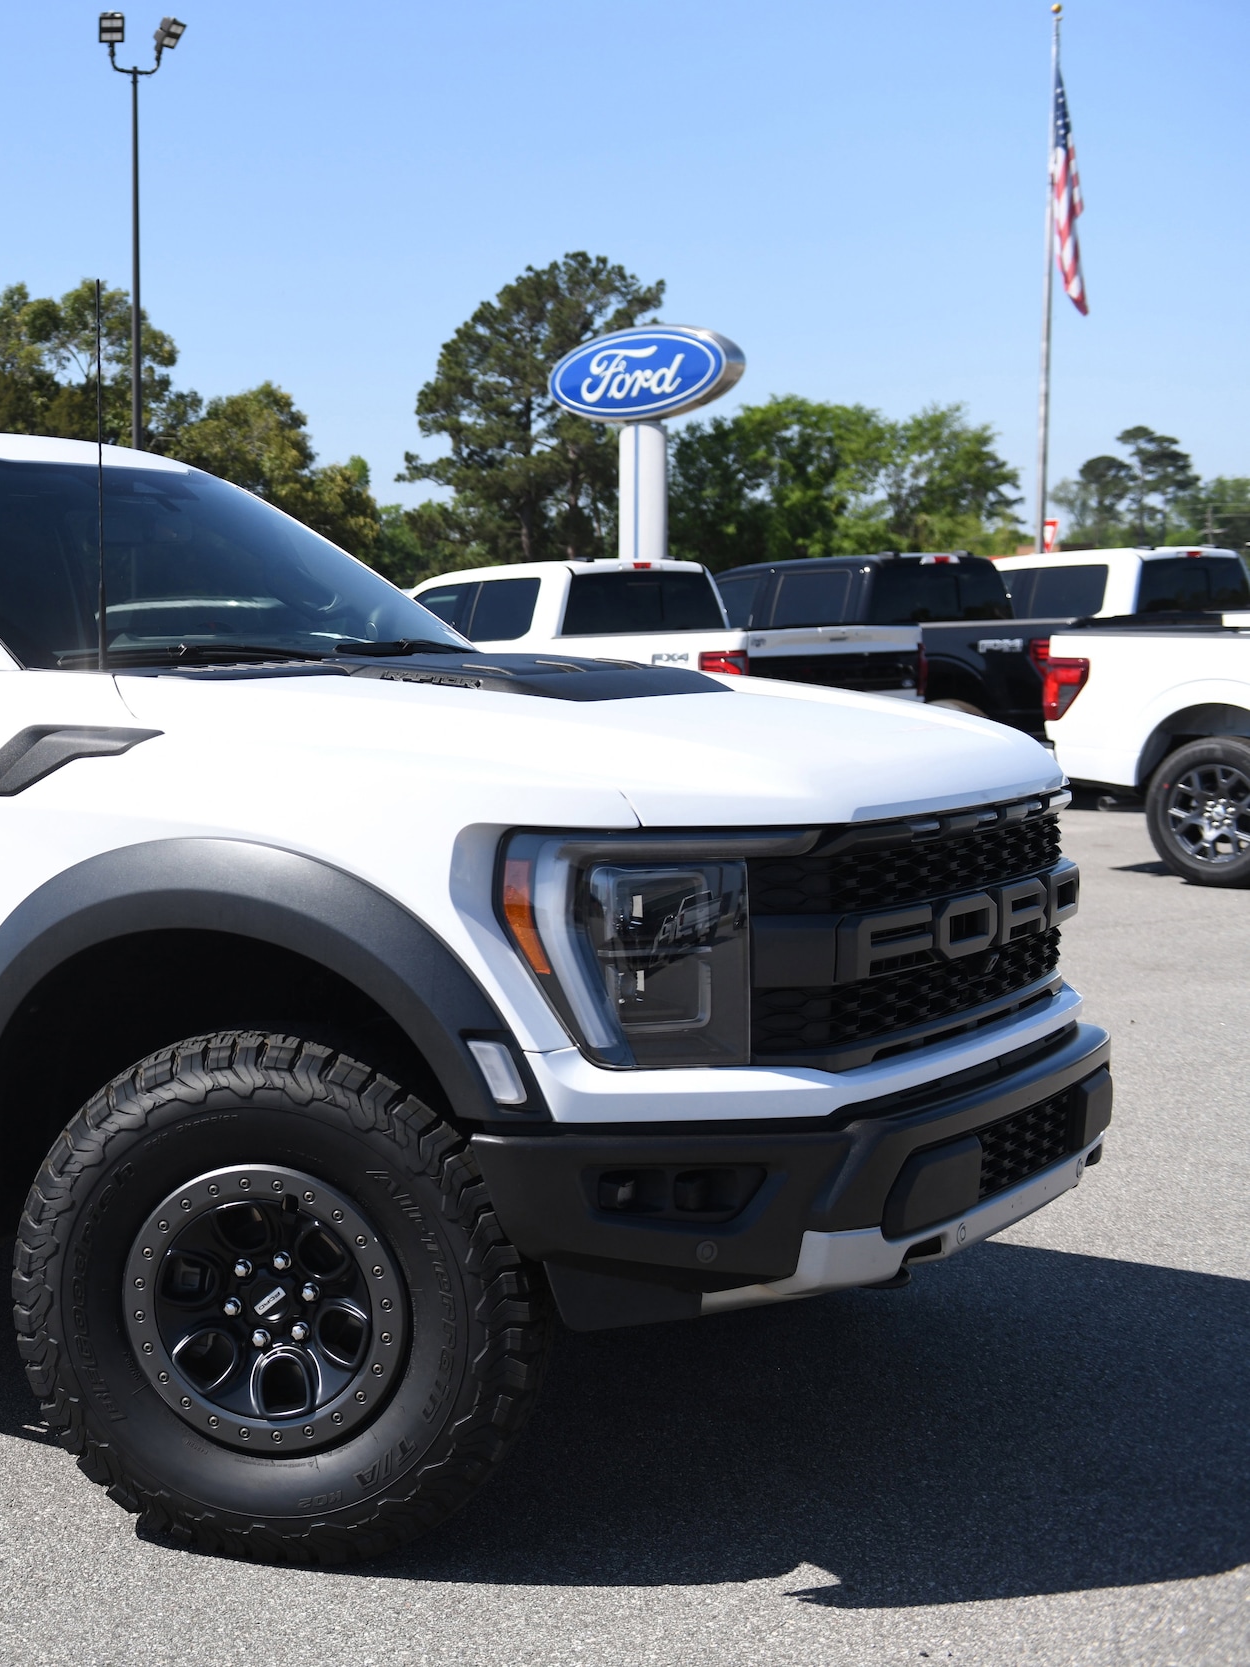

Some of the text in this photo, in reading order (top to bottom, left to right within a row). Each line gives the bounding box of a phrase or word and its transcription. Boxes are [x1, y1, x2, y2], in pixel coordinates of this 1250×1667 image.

[581, 344, 685, 403] Ford
[379, 669, 484, 690] RAPTOR
[651, 653, 689, 666] FX4
[840, 863, 1080, 984] FORD
[71, 1161, 136, 1424] BFGoodrich
